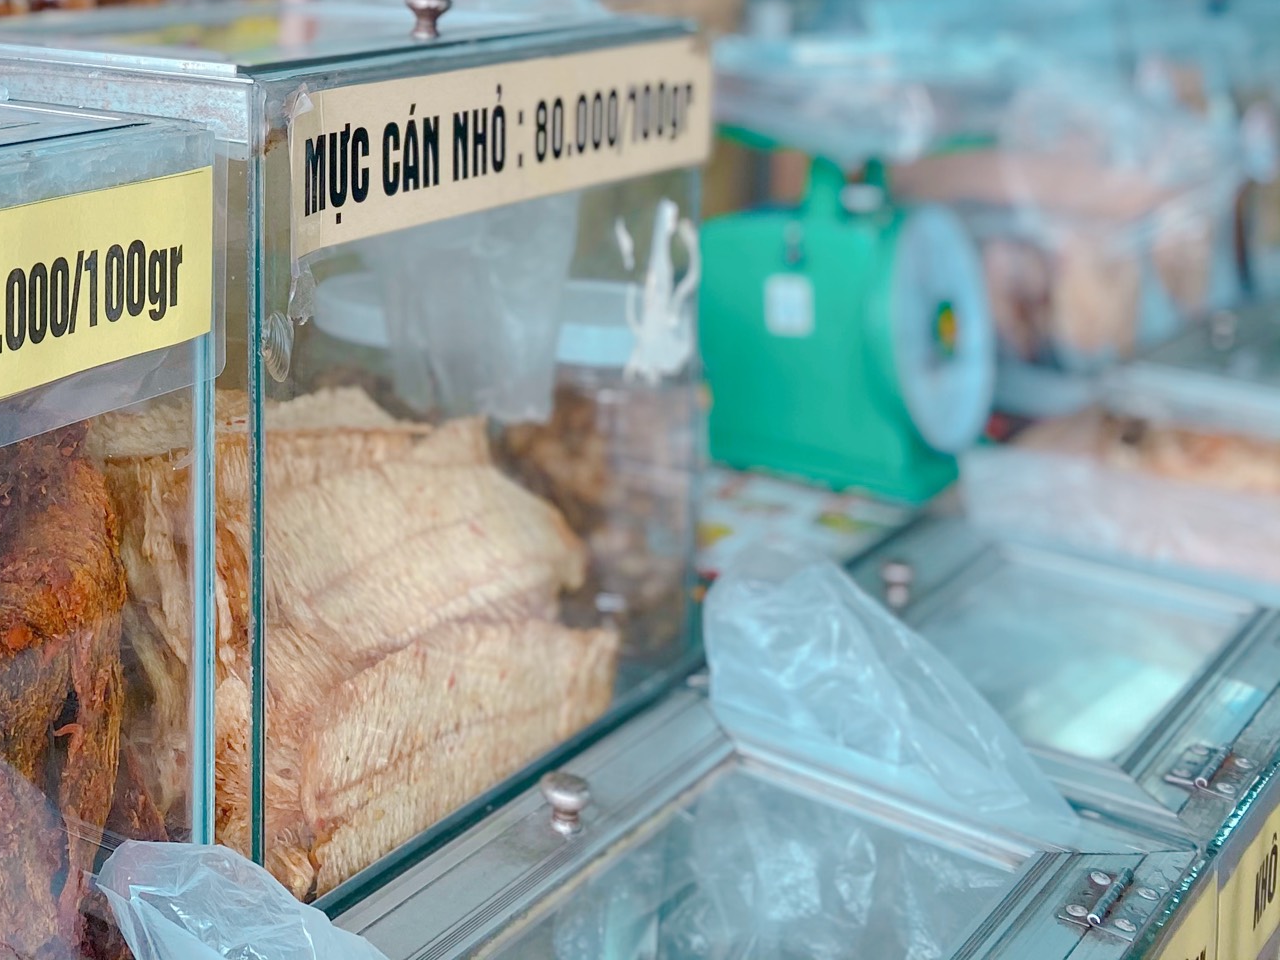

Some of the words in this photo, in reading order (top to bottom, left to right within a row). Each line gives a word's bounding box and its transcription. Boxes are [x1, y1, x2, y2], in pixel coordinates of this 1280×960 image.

[304, 123, 370, 225] MỰC
[382, 103, 440, 197] CÁN
[452, 83, 506, 182] NHỎ
[535, 80, 693, 164] 80.000/100gr
